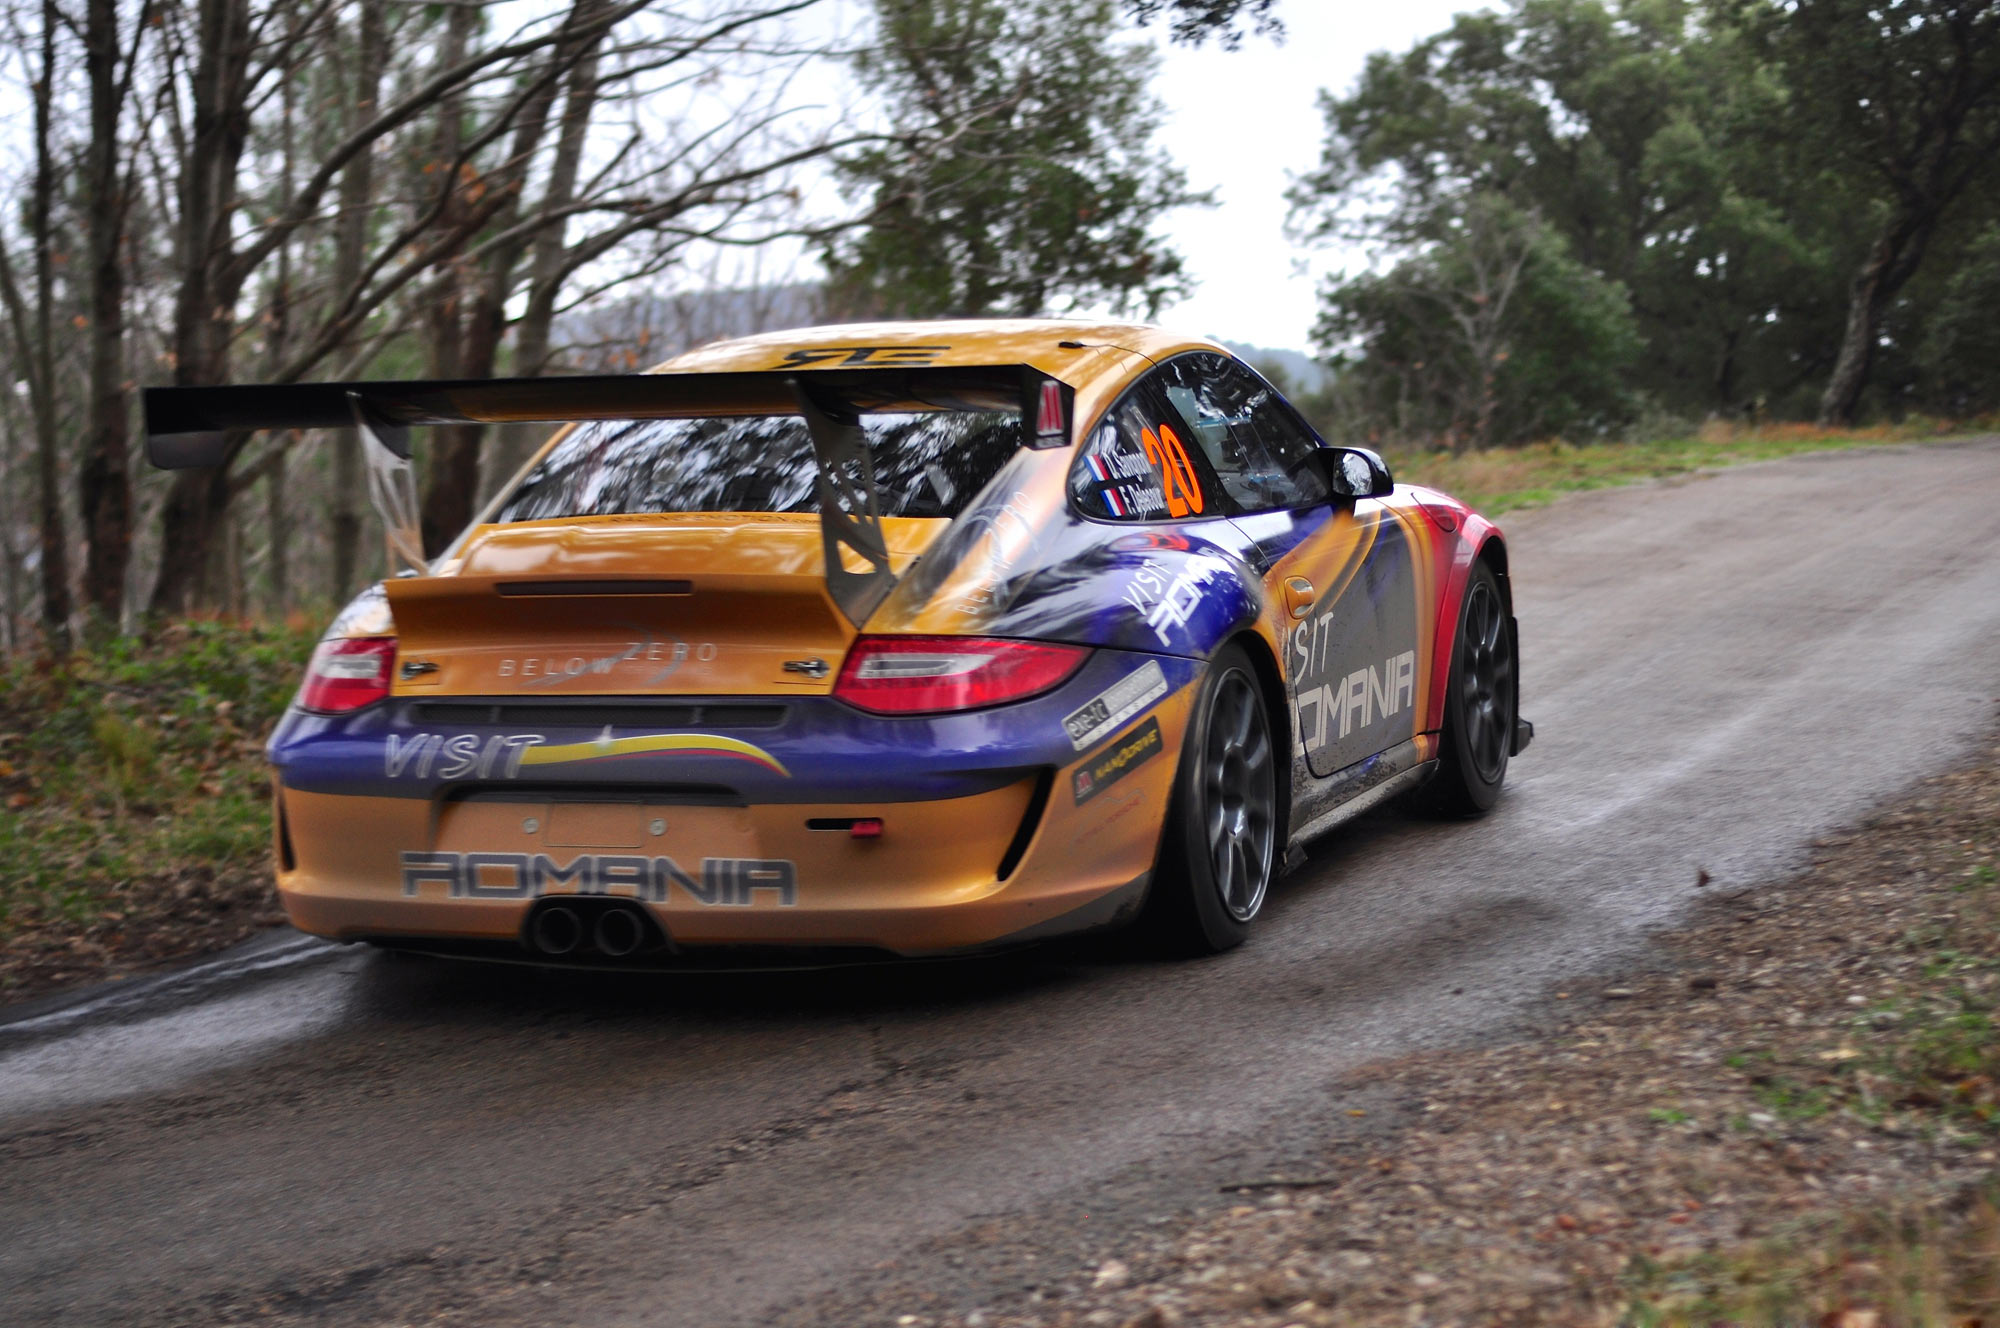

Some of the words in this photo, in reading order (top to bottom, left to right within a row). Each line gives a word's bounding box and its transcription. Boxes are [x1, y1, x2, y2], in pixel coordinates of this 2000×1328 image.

[1141, 424, 1203, 518] 20
[1121, 559, 1172, 616] VISIT
[498, 657, 617, 677] BELOW
[623, 642, 718, 662] ZERO
[384, 733, 546, 779] VISIT
[401, 851, 796, 906] ROMANIA
